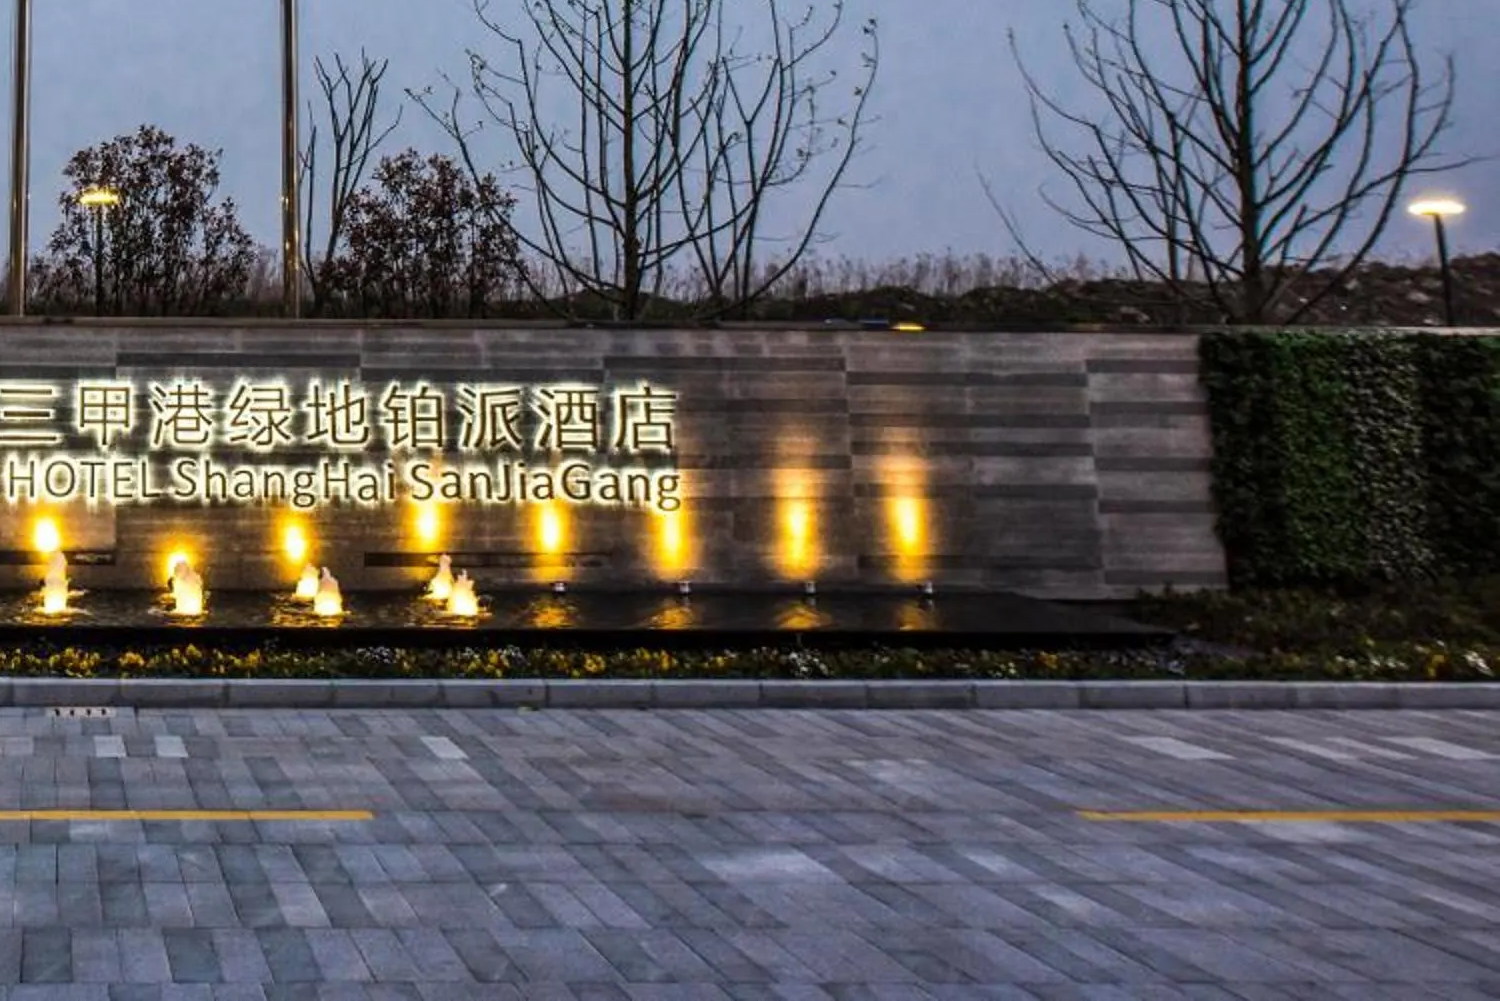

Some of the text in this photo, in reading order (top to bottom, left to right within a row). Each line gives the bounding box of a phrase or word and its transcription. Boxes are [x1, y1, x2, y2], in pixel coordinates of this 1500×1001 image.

[7, 459, 161, 499] HOTEL
[174, 459, 396, 508] ShangHai
[409, 462, 682, 512] SanJiaGang
